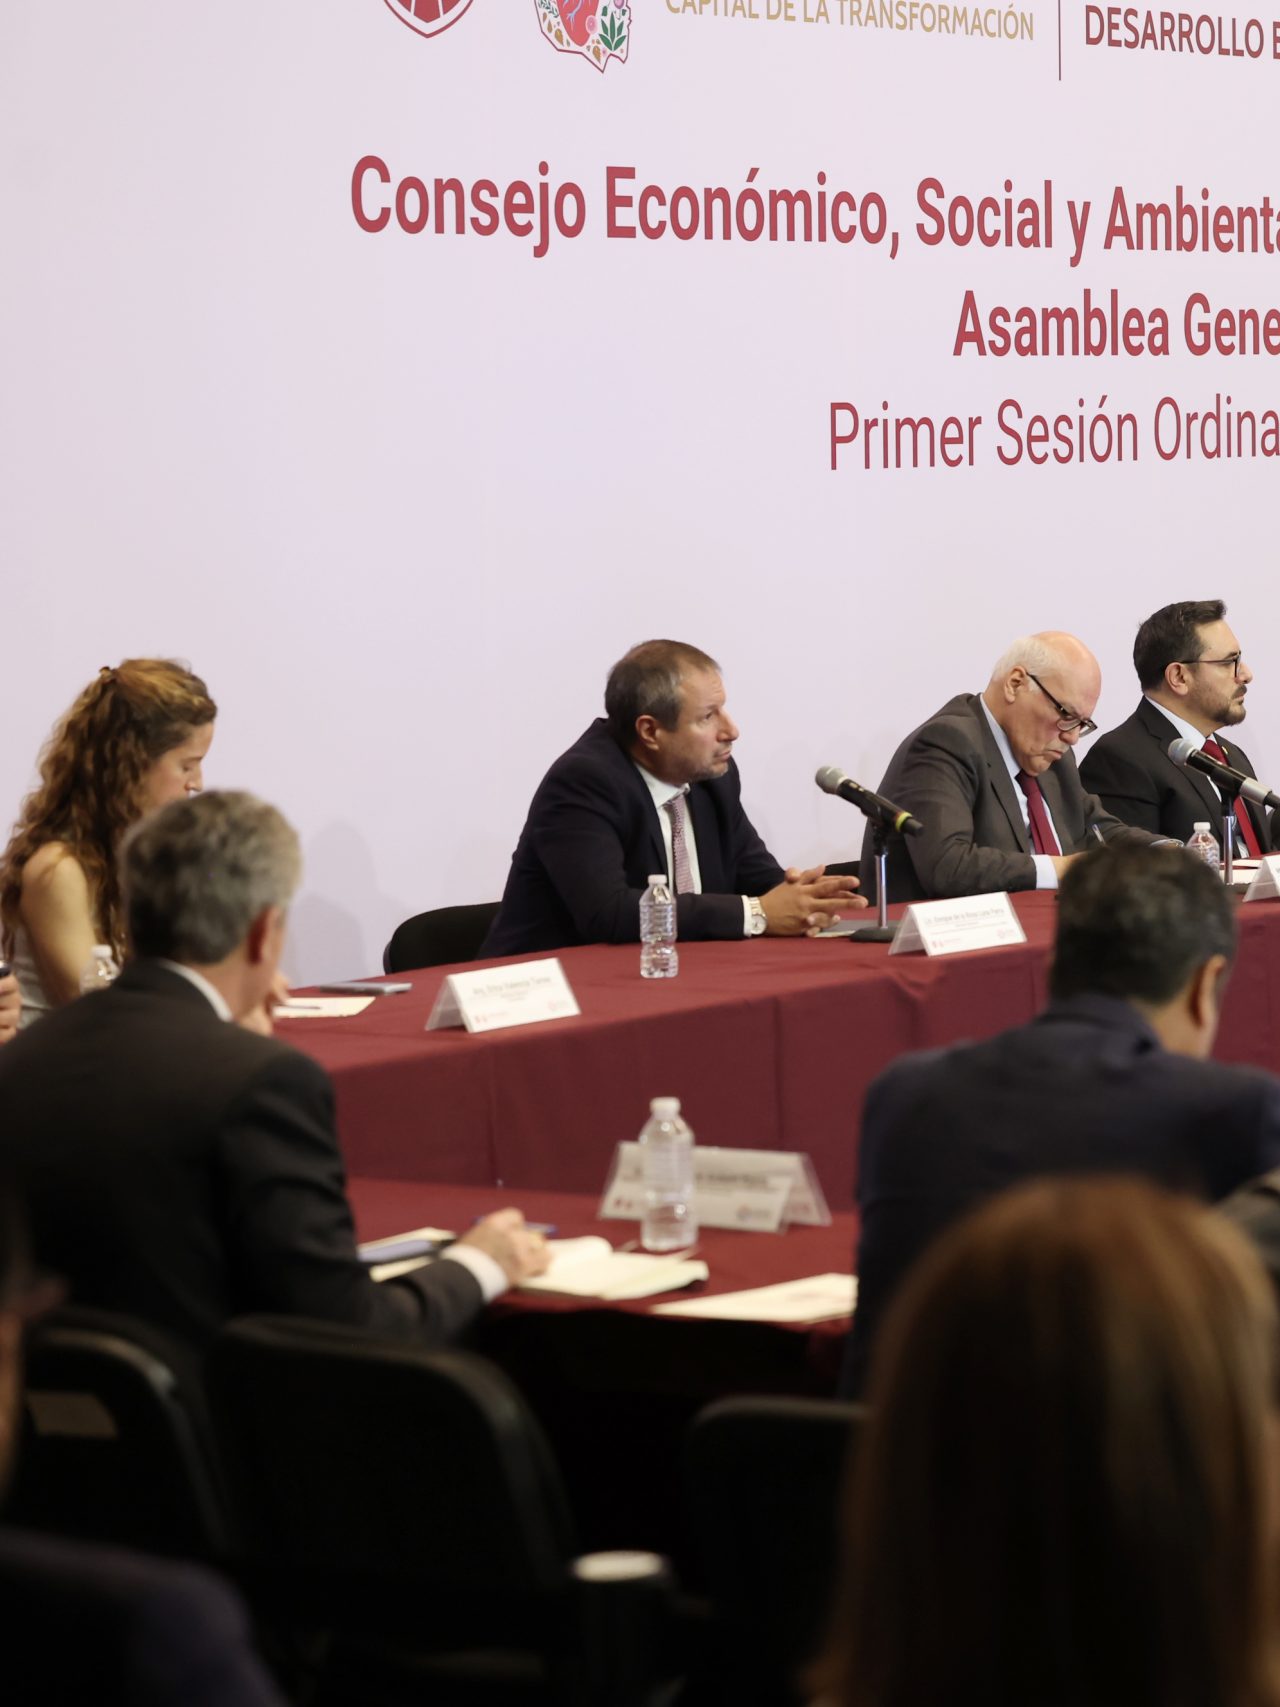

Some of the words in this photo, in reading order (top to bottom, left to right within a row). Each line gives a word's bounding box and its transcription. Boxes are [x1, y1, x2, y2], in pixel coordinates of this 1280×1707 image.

[766, 0, 796, 21] DE
[803, 0, 830, 24] LA
[836, 0, 1033, 40] TRANSFORMACIÓN
[1085, 4, 1264, 58] DESARROLLO
[351, 155, 586, 258] Consejo
[606, 166, 899, 260] Económico,
[916, 177, 1052, 248] Social
[1067, 200, 1091, 268] y
[953, 288, 1170, 357] Asamblea
[830, 401, 982, 470] Primer
[997, 395, 1138, 466] Sesión
